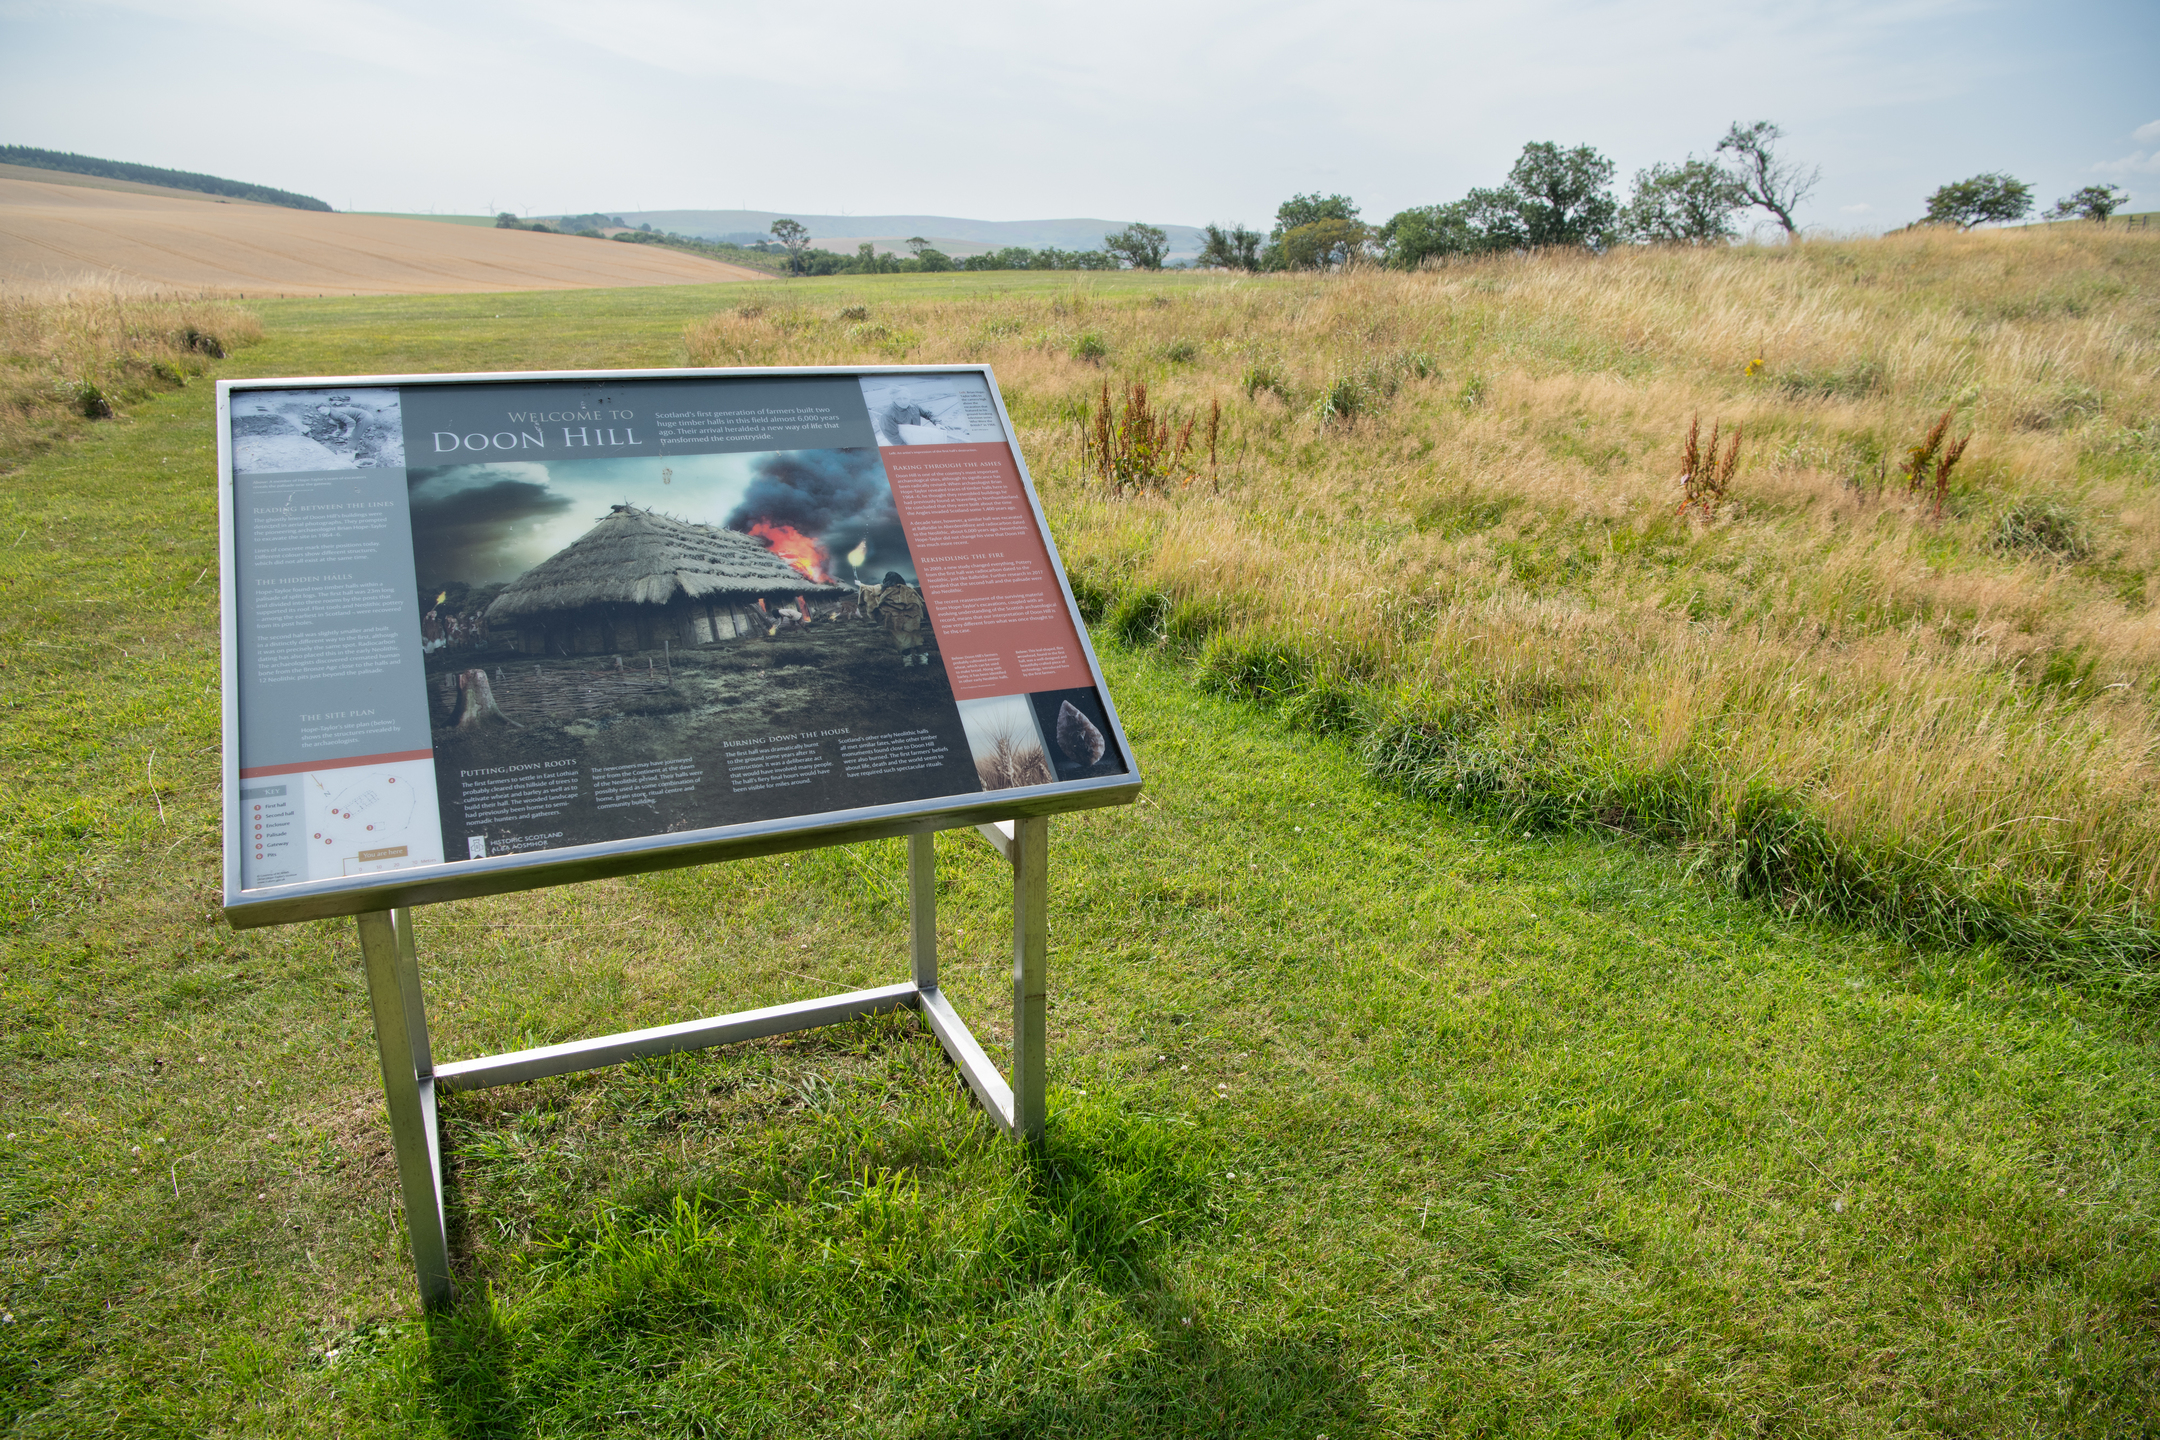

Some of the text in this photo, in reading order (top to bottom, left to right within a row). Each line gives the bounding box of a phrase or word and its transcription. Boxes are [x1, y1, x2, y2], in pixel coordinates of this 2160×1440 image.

[508, 410, 634, 423] WELCOME TO
[656, 411, 695, 419] Scotland's
[714, 409, 756, 418] generation
[766, 407, 795, 415] farmers
[656, 419, 677, 428] huge
[678, 418, 705, 426] timber
[735, 416, 750, 424] this
[797, 414, 819, 423] 6,000
[785, 424, 800, 432] way
[432, 427, 643, 452] DOON HILL
[660, 435, 709, 443] transformed
[726, 432, 774, 442] countryside.
[723, 728, 850, 748] BURNING DOWN THE HOUSE
[770, 743, 803, 753] dramatically
[744, 755, 764, 764] ground
[460, 758, 577, 777] PUTTING DOWN ROOTS
[487, 777, 510, 785] farmers
[556, 769, 579, 777] Lothian
[462, 787, 490, 796] probably
[490, 784, 513, 792] cleared
[526, 780, 547, 788] hillside
[463, 794, 490, 803] cultivate
[491, 792, 510, 800] wheat
[523, 788, 542, 797] barley
[490, 832, 563, 846] HISTORIC SCOTLAND
